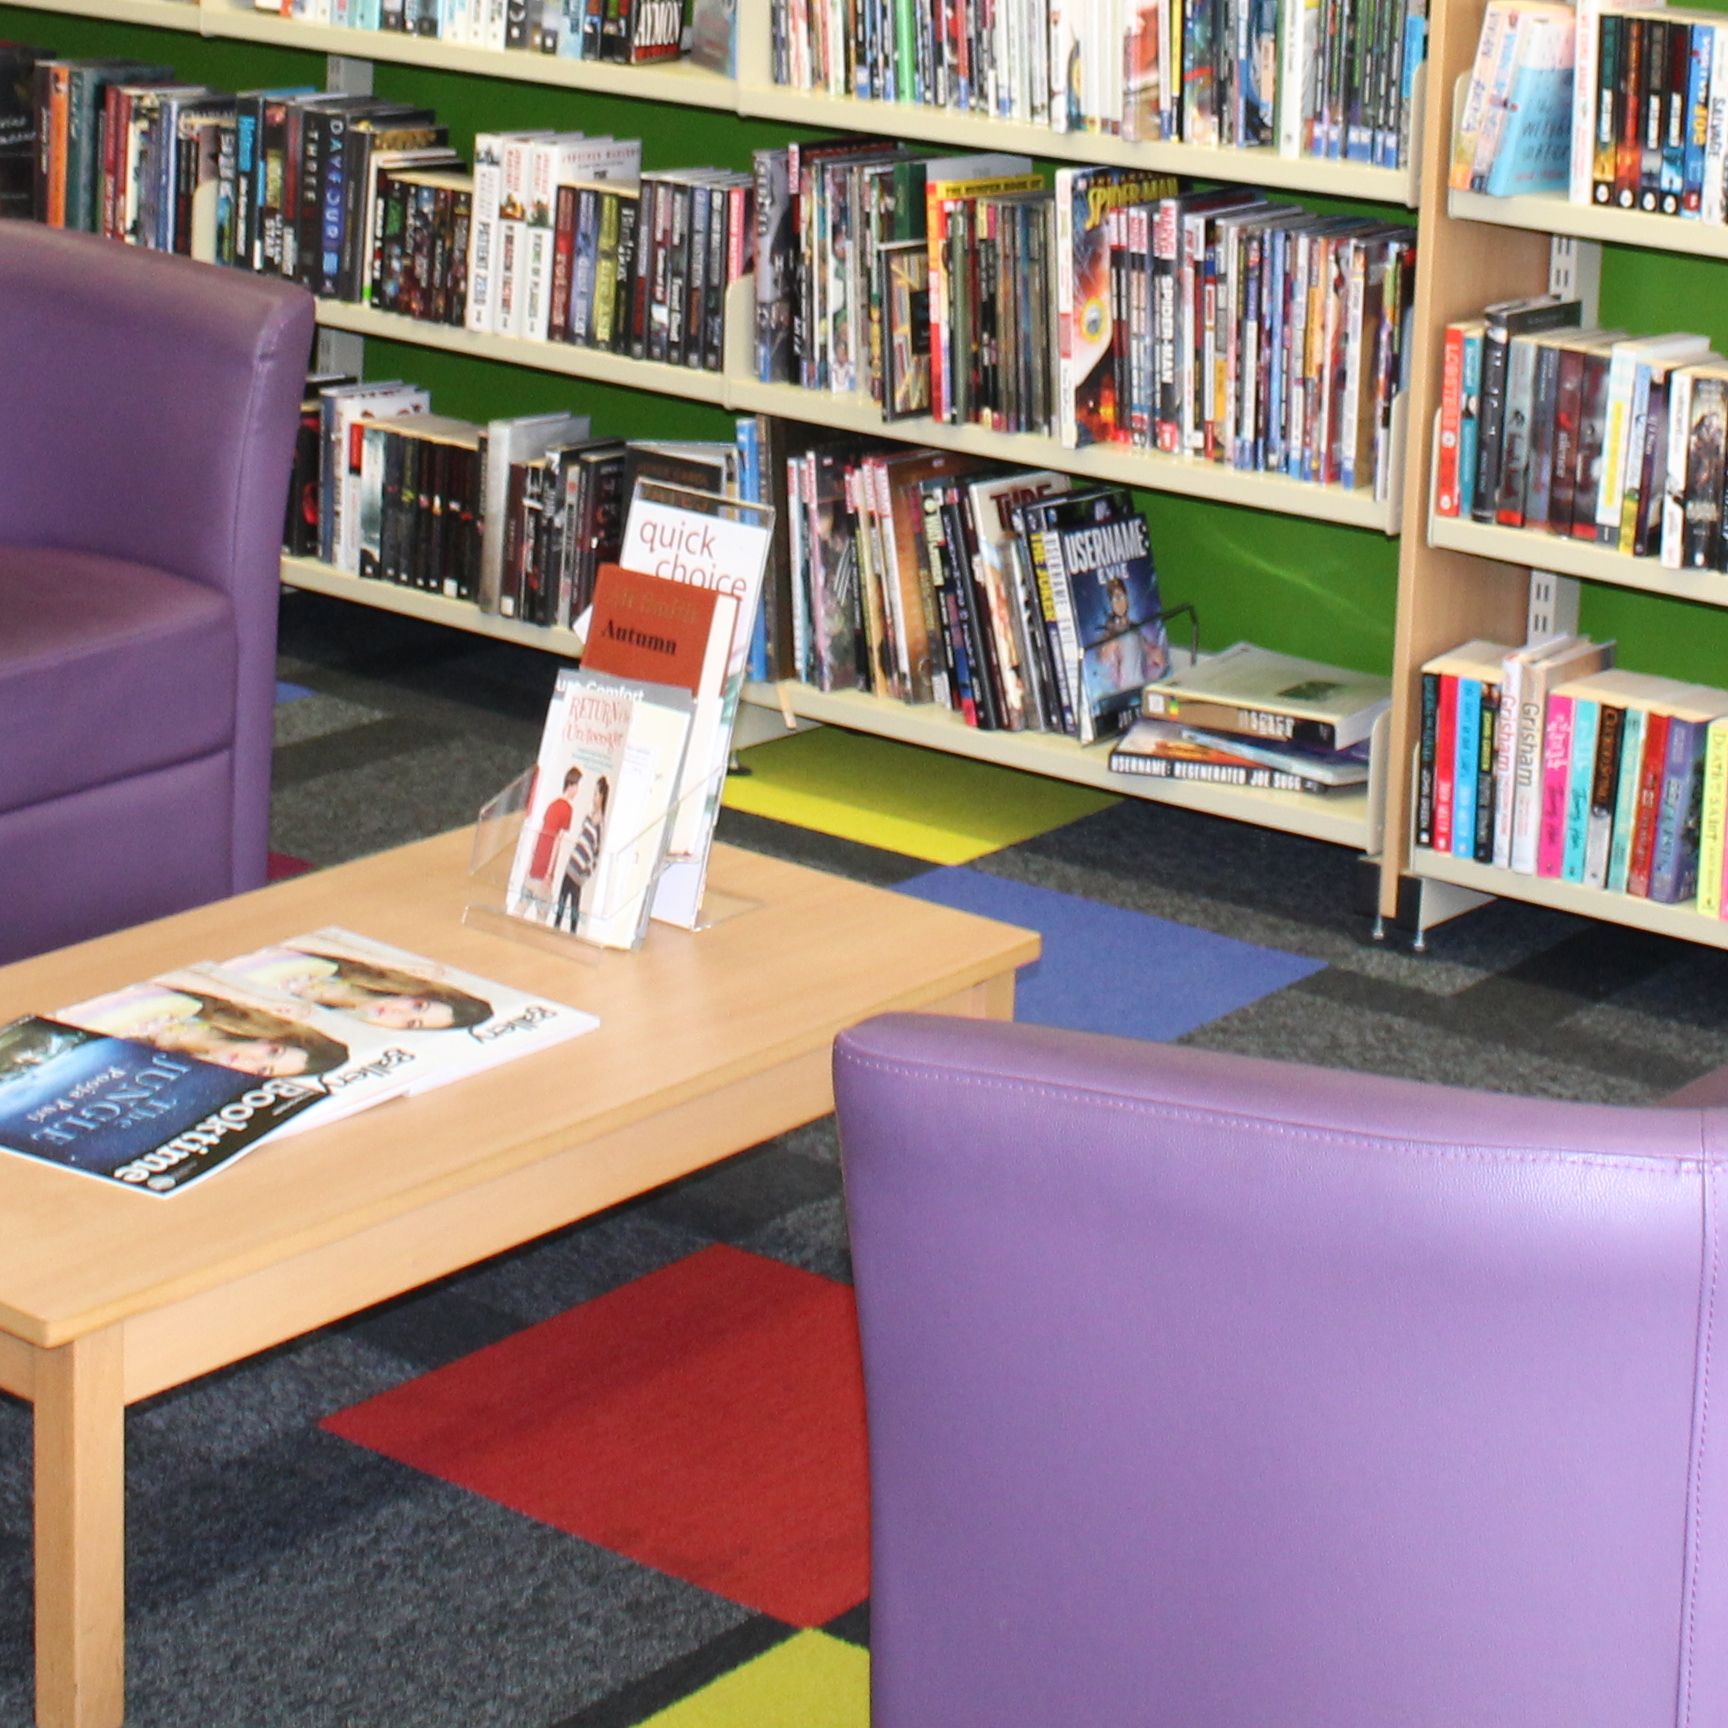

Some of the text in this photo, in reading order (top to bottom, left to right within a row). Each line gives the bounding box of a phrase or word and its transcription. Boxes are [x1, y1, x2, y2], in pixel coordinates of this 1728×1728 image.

[1709, 97, 1727, 158] SALVAGE
[474, 222, 490, 270] PATIENT
[1159, 204, 1177, 383] MARVEL SPIDER-MAN
[640, 517, 716, 560] quick
[1063, 517, 1150, 574] USERNAME:
[656, 555, 747, 597] choice
[603, 620, 677, 657] Autumn
[1496, 695, 1518, 771] Grisham
[1517, 702, 1543, 787] Grisham
[1110, 753, 1172, 778] USERNAME:
[467, 1003, 559, 1045] gallery
[305, 1043, 418, 1096] gallery
[31, 1051, 193, 1146] JUNGLE
[114, 1074, 306, 1187] Booktime
